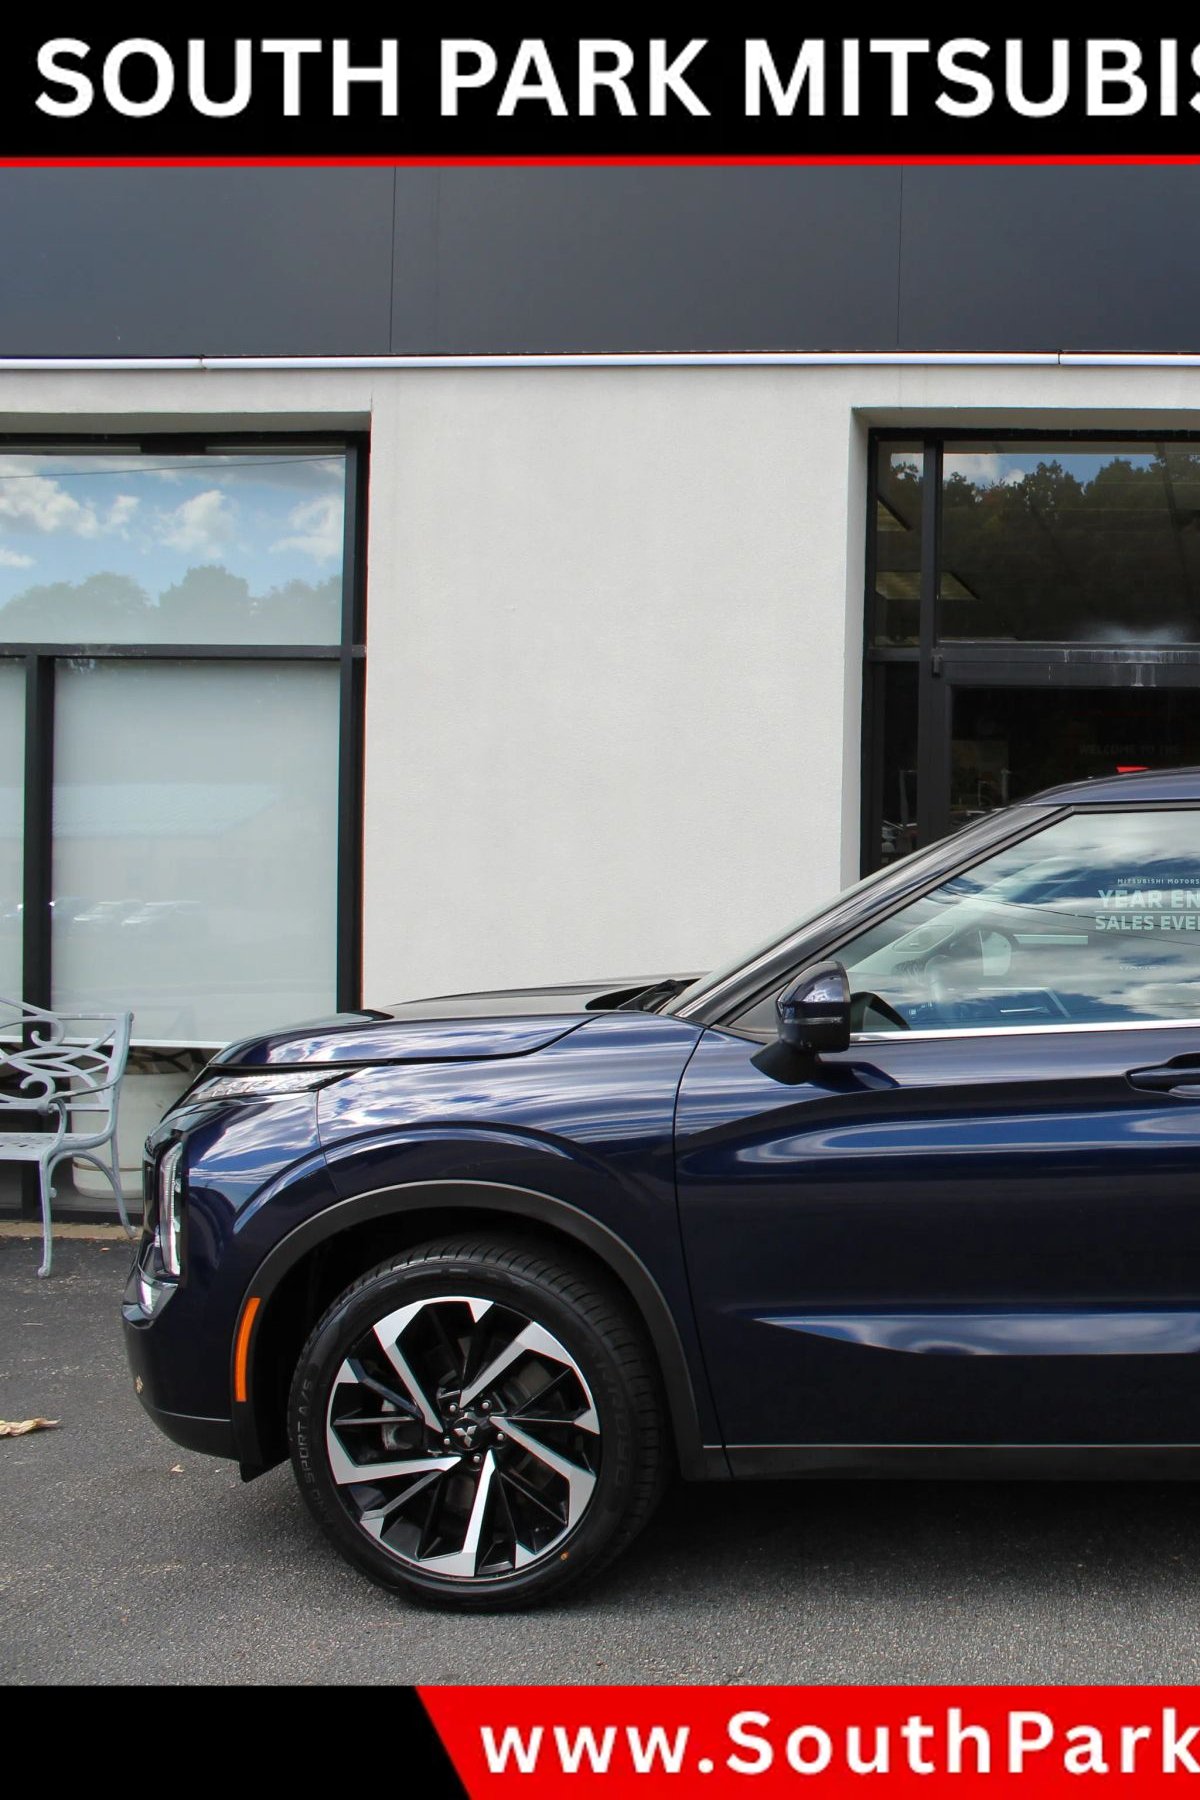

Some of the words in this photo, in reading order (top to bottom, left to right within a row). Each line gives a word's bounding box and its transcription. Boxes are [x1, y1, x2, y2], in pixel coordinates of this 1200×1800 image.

[1097, 889, 1163, 909] YEAR
[1095, 915, 1155, 931] SALES
[296, 1420, 315, 1484] SPORT
